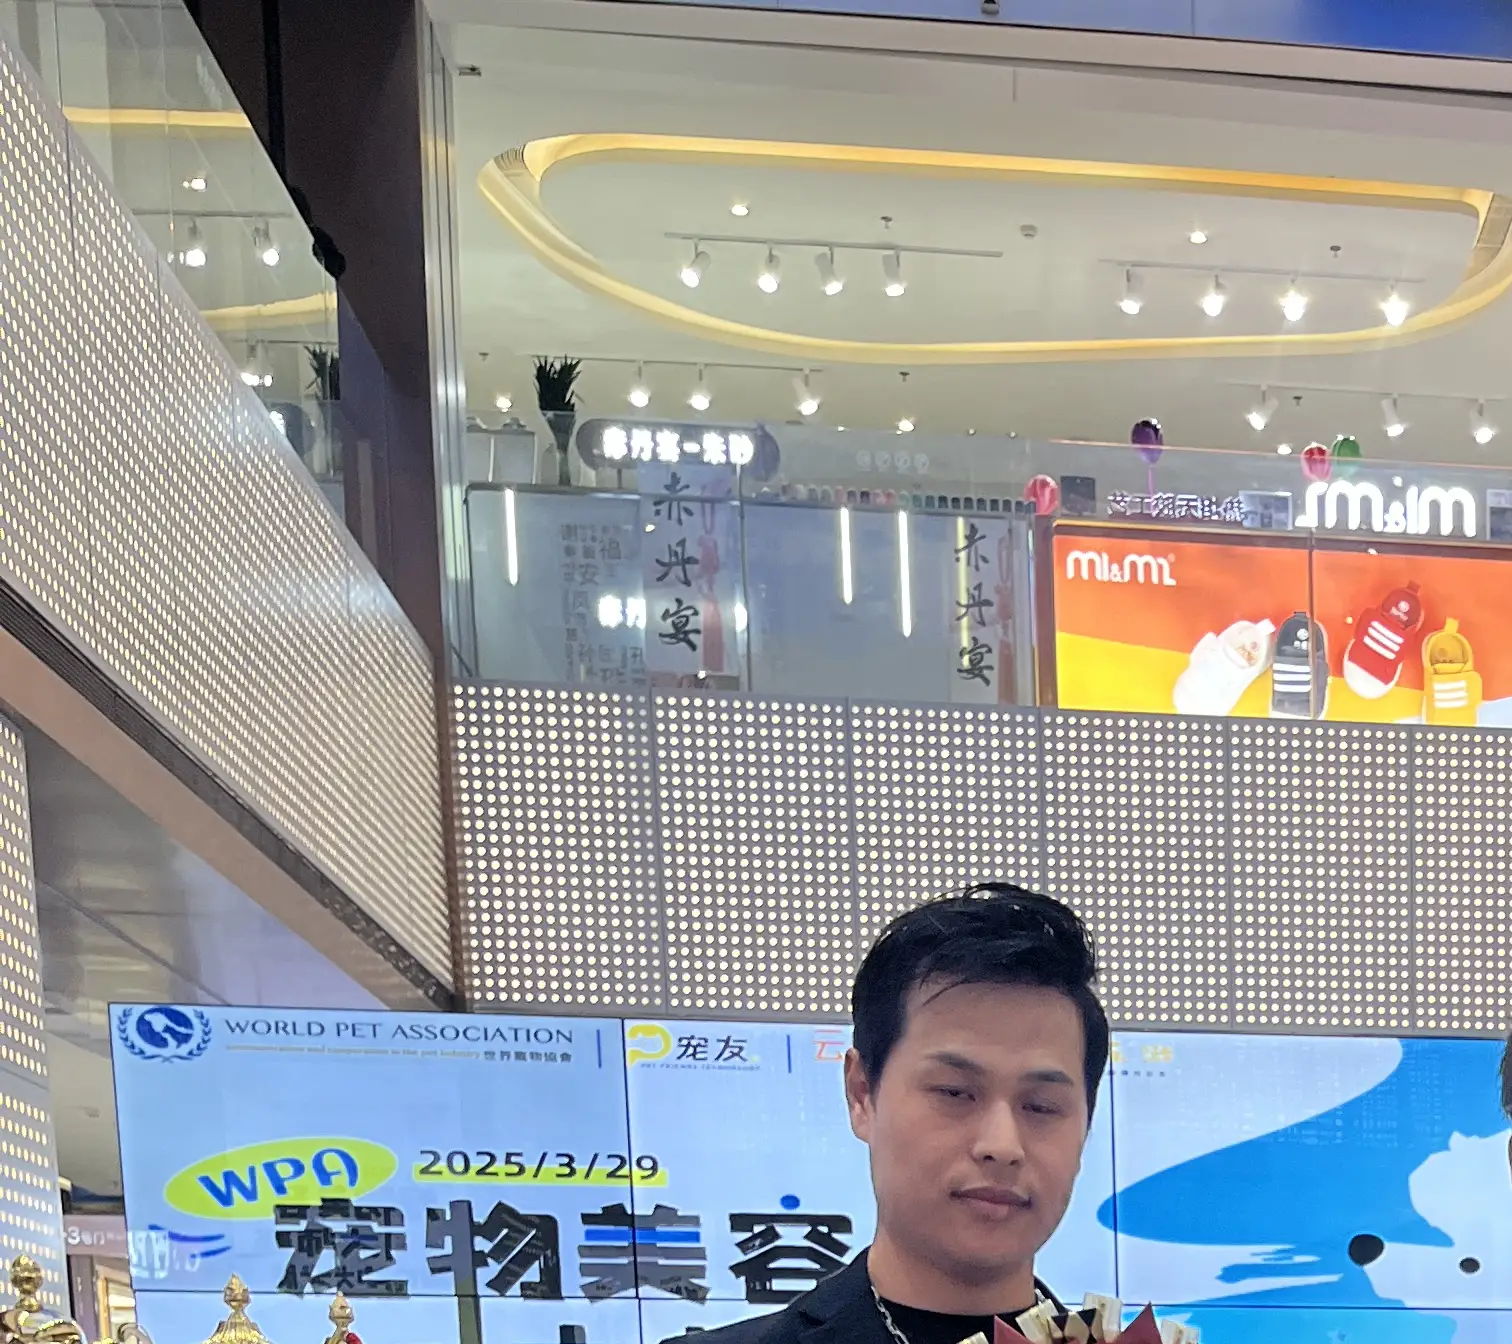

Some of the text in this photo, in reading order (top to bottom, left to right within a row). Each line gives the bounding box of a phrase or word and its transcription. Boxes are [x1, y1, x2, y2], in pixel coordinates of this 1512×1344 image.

[224, 1018, 575, 1046] WORLD PET ASSOCIATION
[677, 1035, 749, 1063] 宠友
[197, 1147, 361, 1208] WPA
[419, 1149, 660, 1182] 2025/3/29
